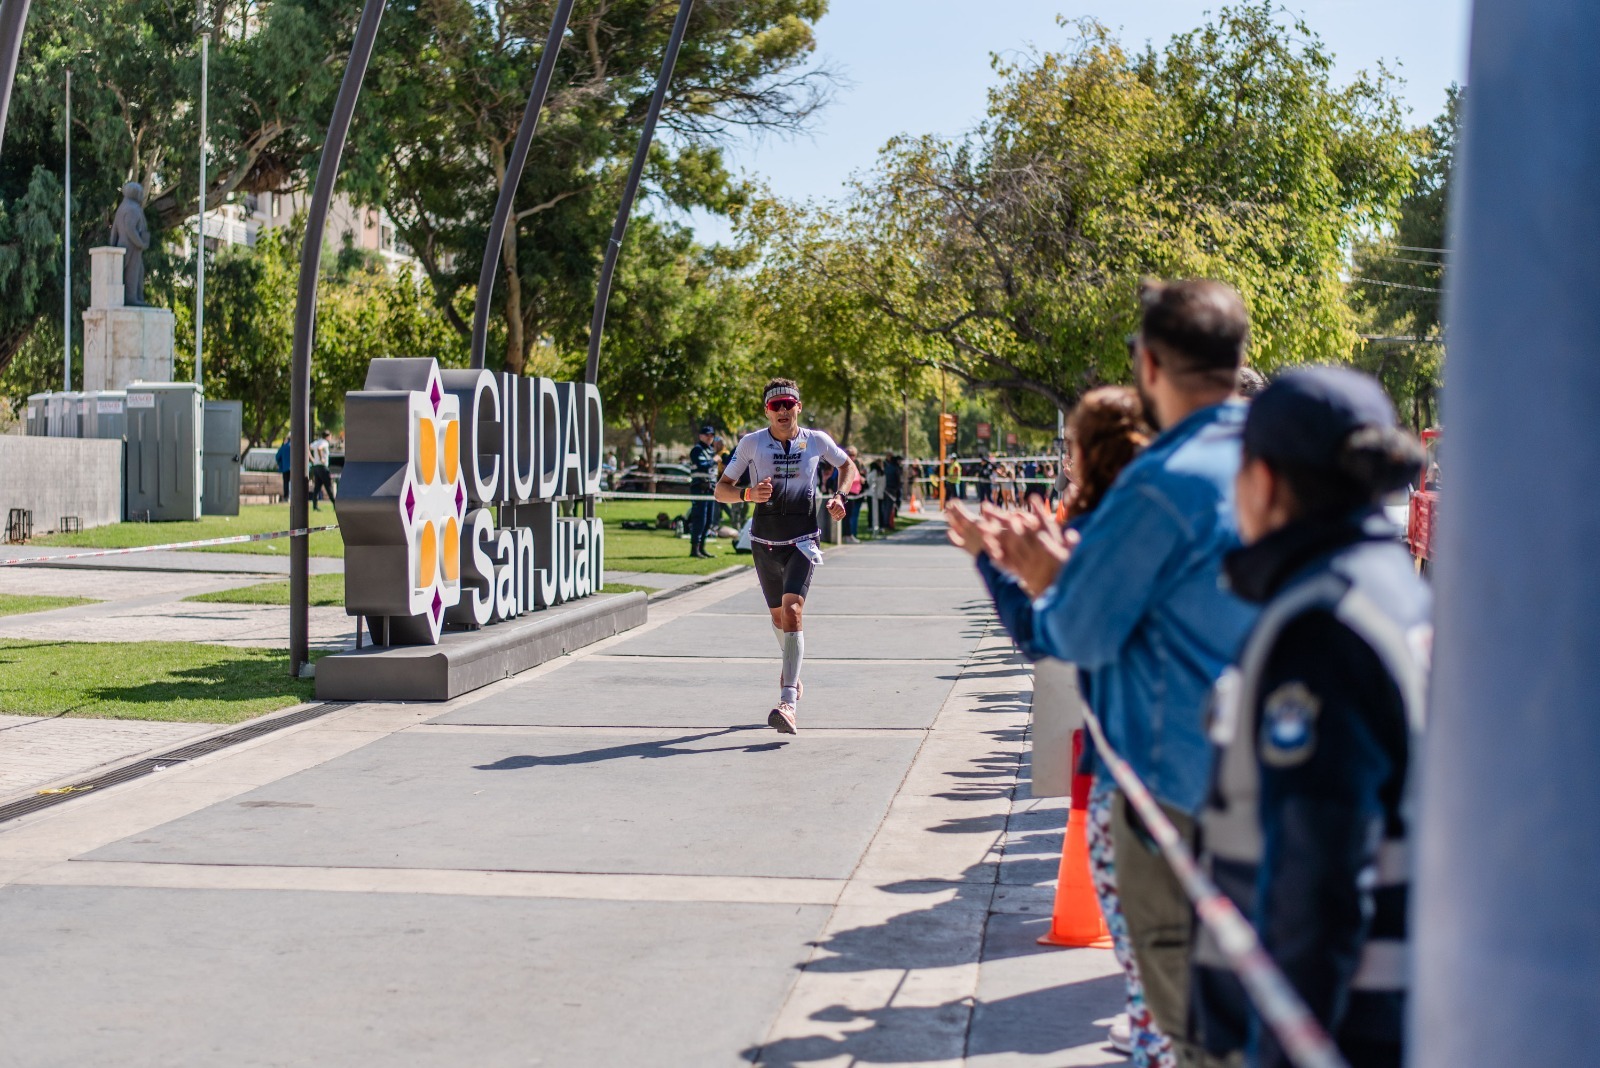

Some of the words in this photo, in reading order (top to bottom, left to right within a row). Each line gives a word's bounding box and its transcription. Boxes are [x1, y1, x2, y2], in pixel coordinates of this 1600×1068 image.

[472, 369, 604, 502] CIUDAD
[472, 507, 535, 625] San
[540, 501, 604, 606] Juan
